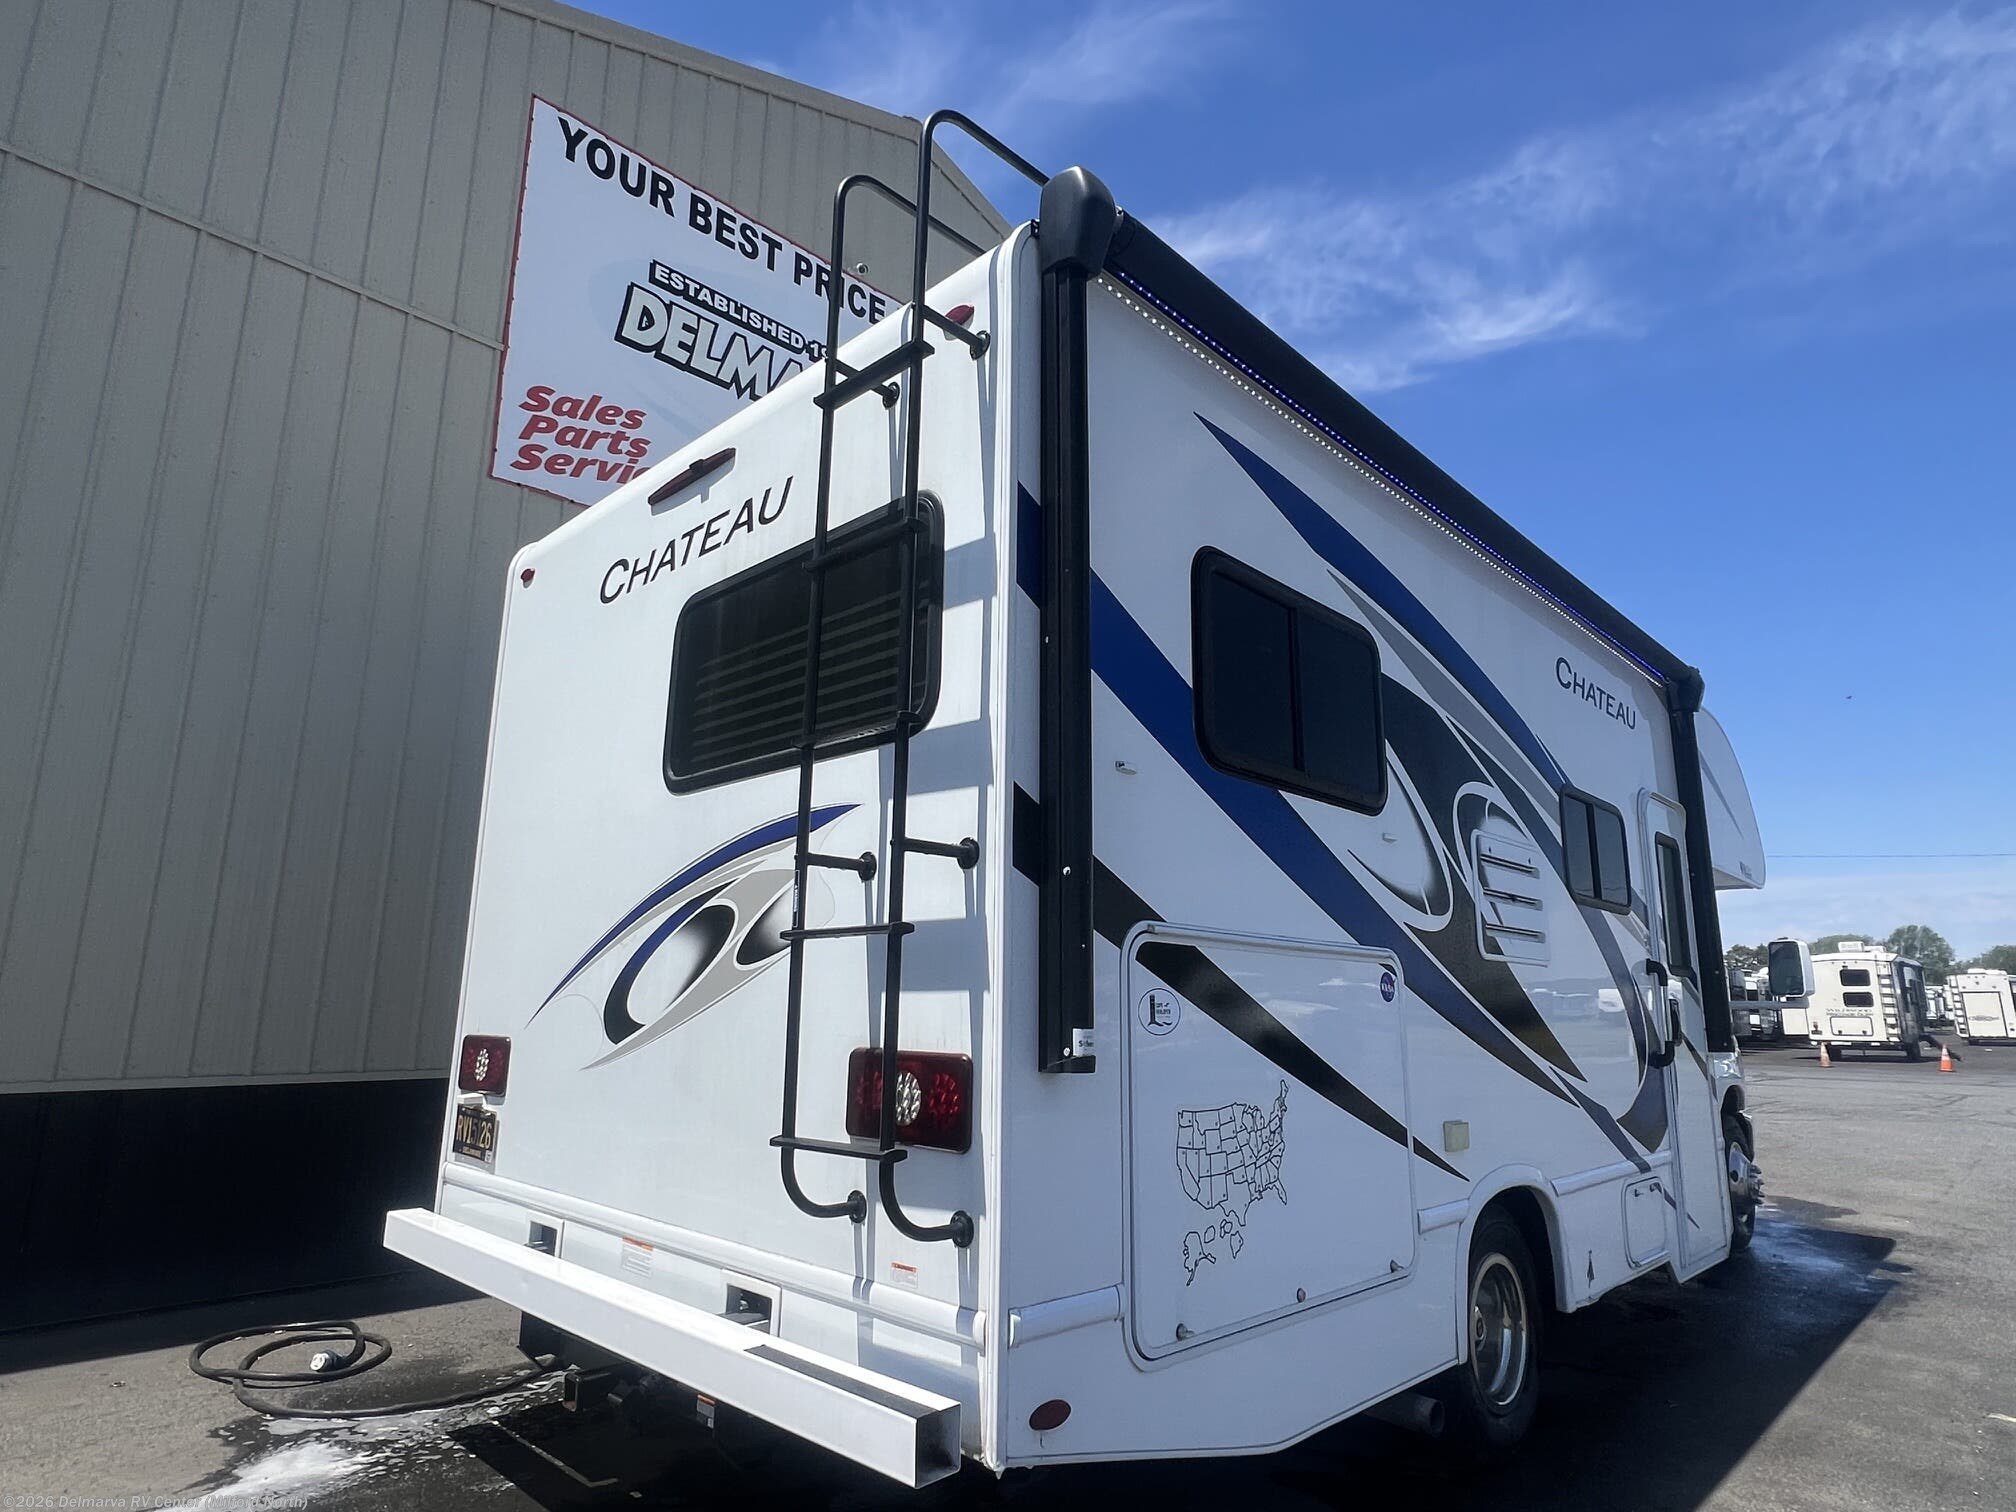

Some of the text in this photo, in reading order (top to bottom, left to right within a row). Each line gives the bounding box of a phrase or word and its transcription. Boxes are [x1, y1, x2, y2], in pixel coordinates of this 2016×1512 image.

[558, 116, 675, 217] YOUR
[688, 192, 783, 272] BEST
[652, 262, 805, 352] ESTABLISHED
[518, 415, 651, 458] Parts
[519, 385, 647, 429] Sales
[600, 476, 793, 604] CHATEAU
[1556, 657, 1636, 730] CHATEAU
